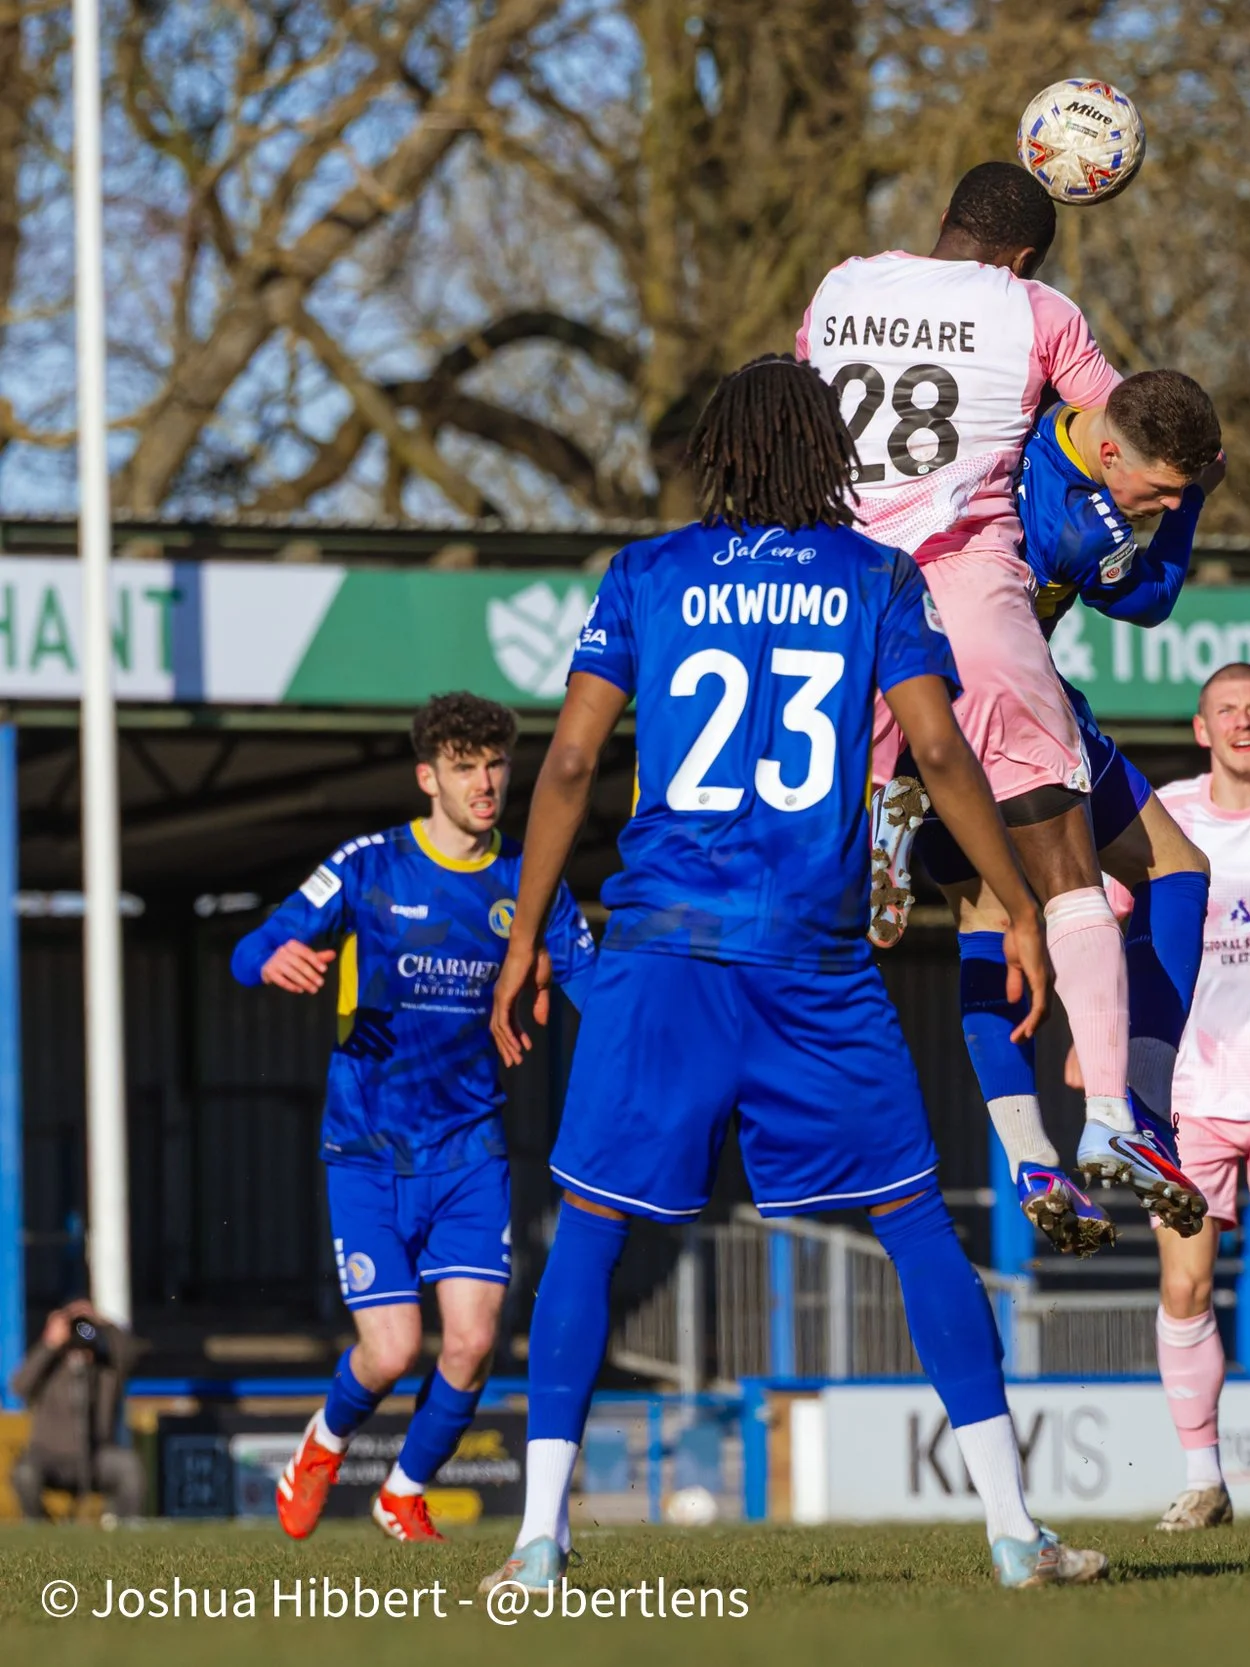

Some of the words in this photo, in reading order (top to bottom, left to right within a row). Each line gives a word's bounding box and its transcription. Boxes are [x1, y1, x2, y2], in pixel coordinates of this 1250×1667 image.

[1064, 101, 1113, 125] Mitre
[823, 316, 976, 353] SANGARE
[831, 363, 960, 484] 28
[682, 582, 849, 627] OKWUMO
[1053, 602, 1098, 682] &
[665, 648, 846, 813] 23
[397, 953, 500, 979] CHARMED
[1221, 953, 1236, 966] UK
[909, 1408, 1112, 1499] KYIS
